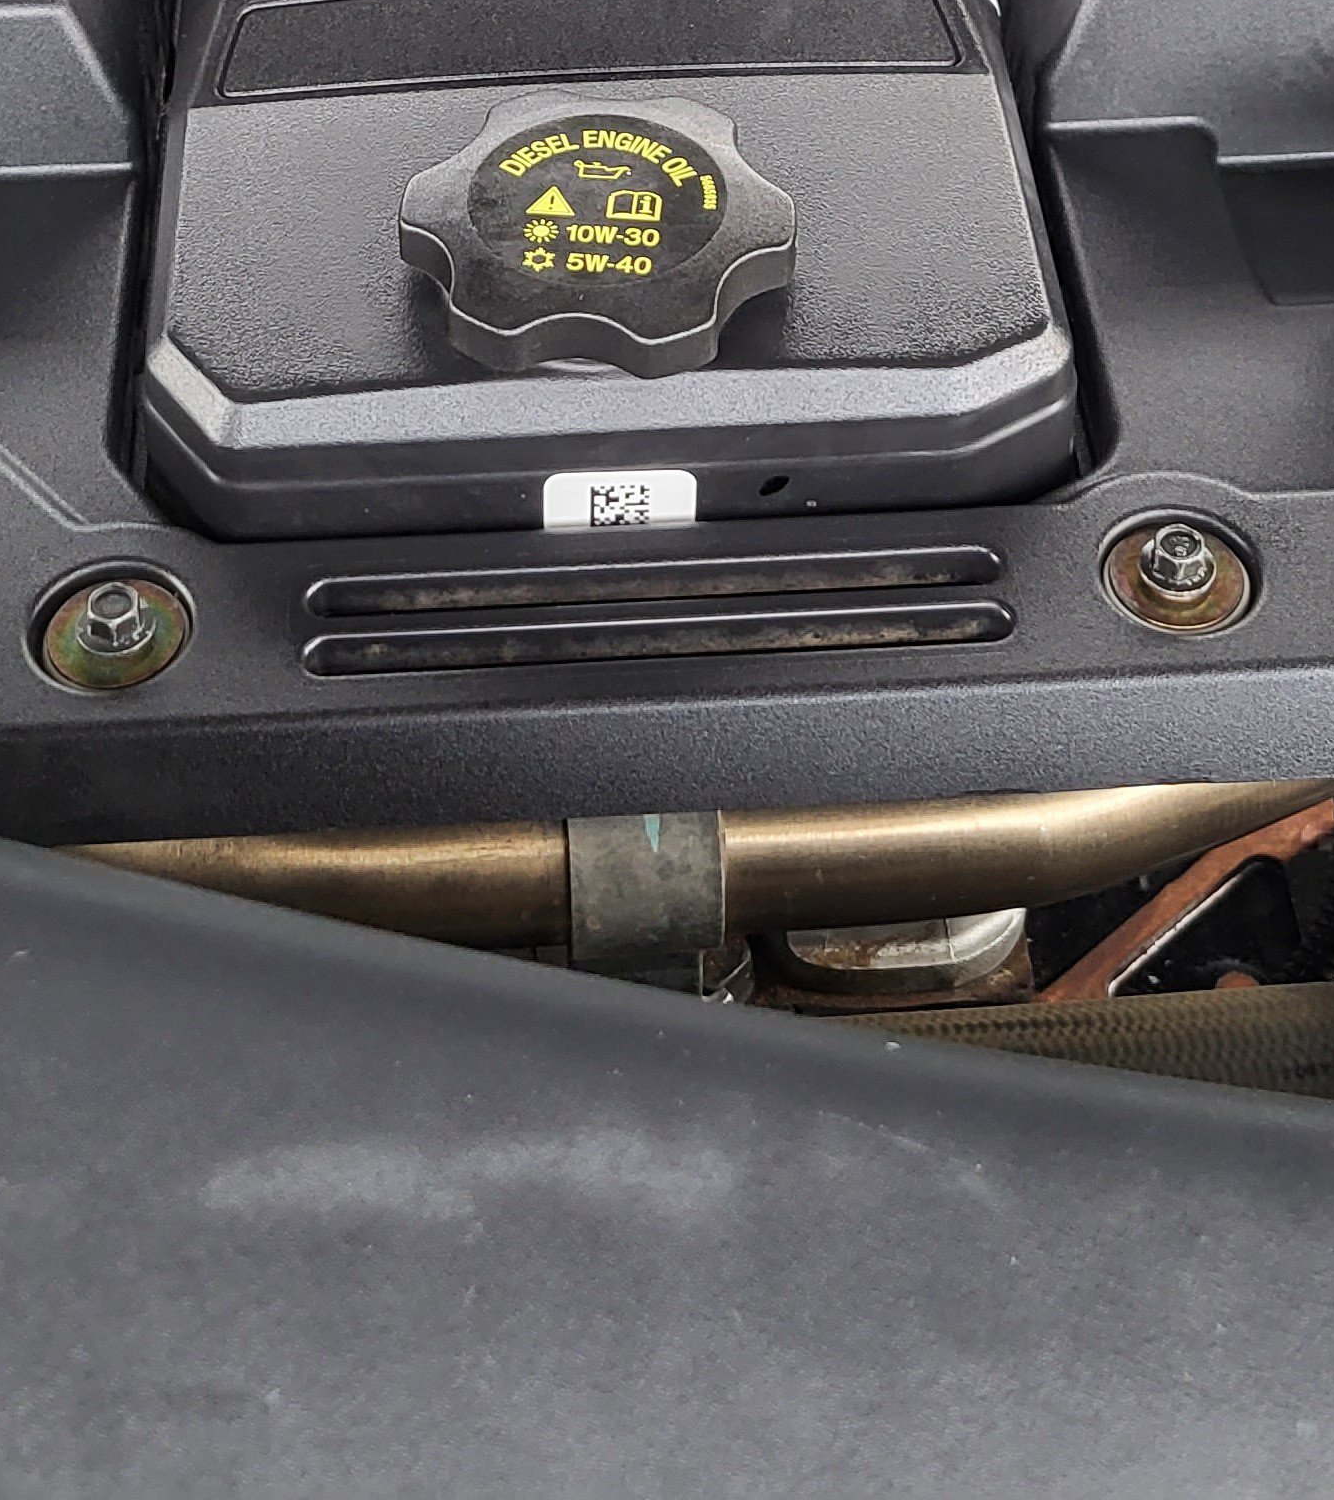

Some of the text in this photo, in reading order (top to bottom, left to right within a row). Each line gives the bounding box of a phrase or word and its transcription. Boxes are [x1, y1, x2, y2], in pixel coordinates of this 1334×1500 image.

[499, 129, 698, 188] DIESEL ENGINE OIL
[566, 224, 660, 248] 10W-30
[566, 253, 652, 276] 5W-40
